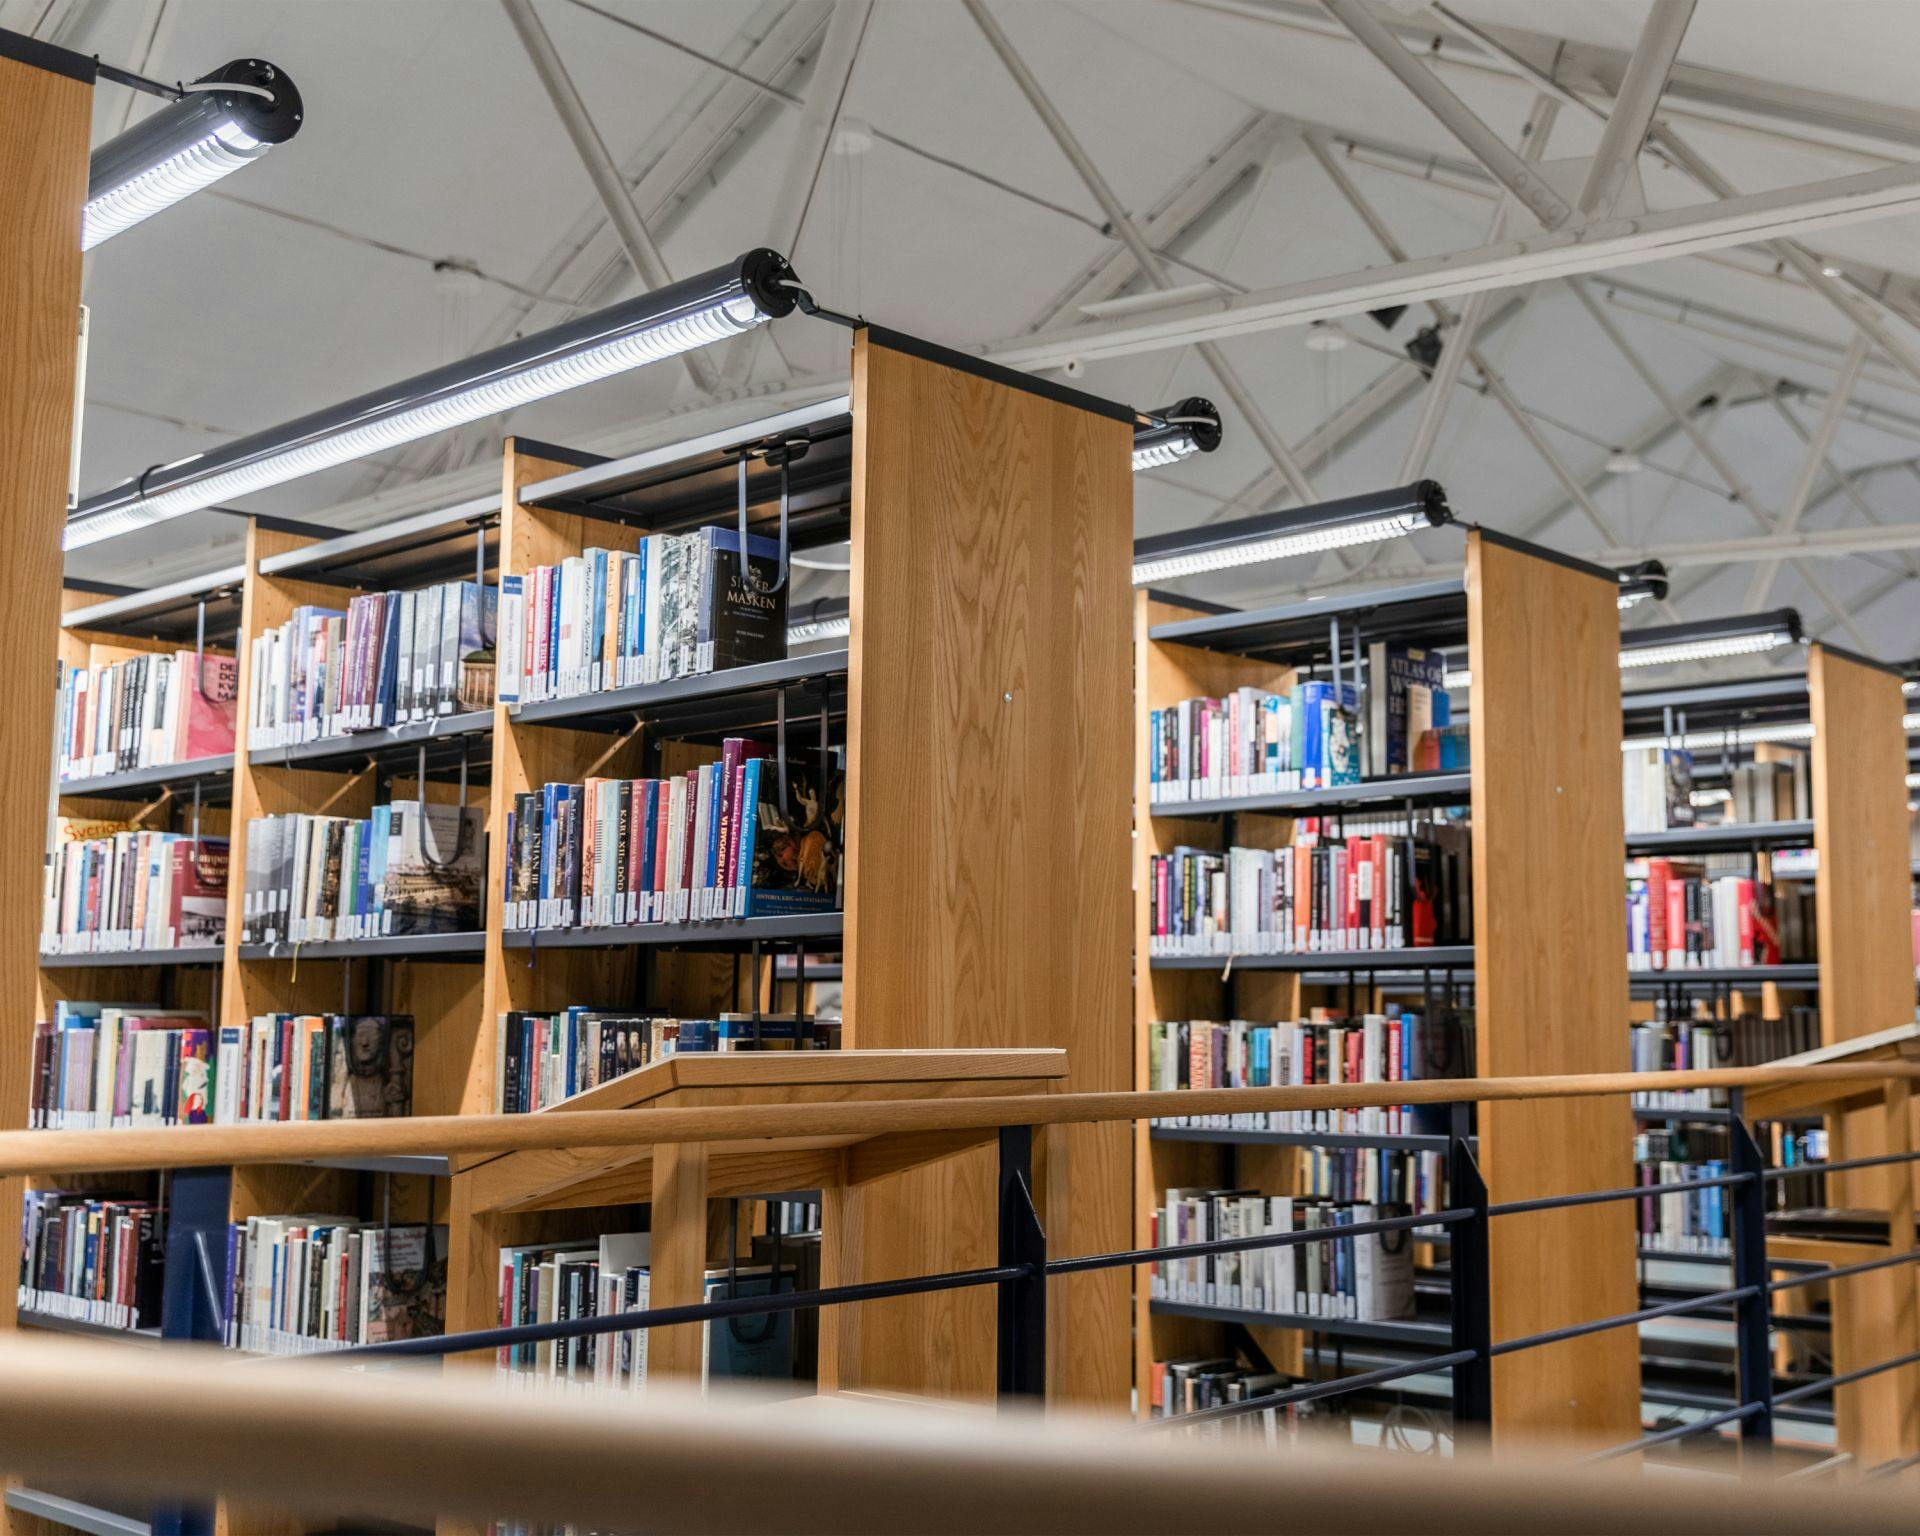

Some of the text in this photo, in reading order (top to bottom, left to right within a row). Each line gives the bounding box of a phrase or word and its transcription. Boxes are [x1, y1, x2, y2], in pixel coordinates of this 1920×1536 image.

[727, 589, 776, 610] MASKEN
[619, 808, 627, 837] KARL
[531, 832, 541, 884] JOHAN III
[718, 826, 728, 868] BYGGER
[616, 866, 626, 891] DÖD
